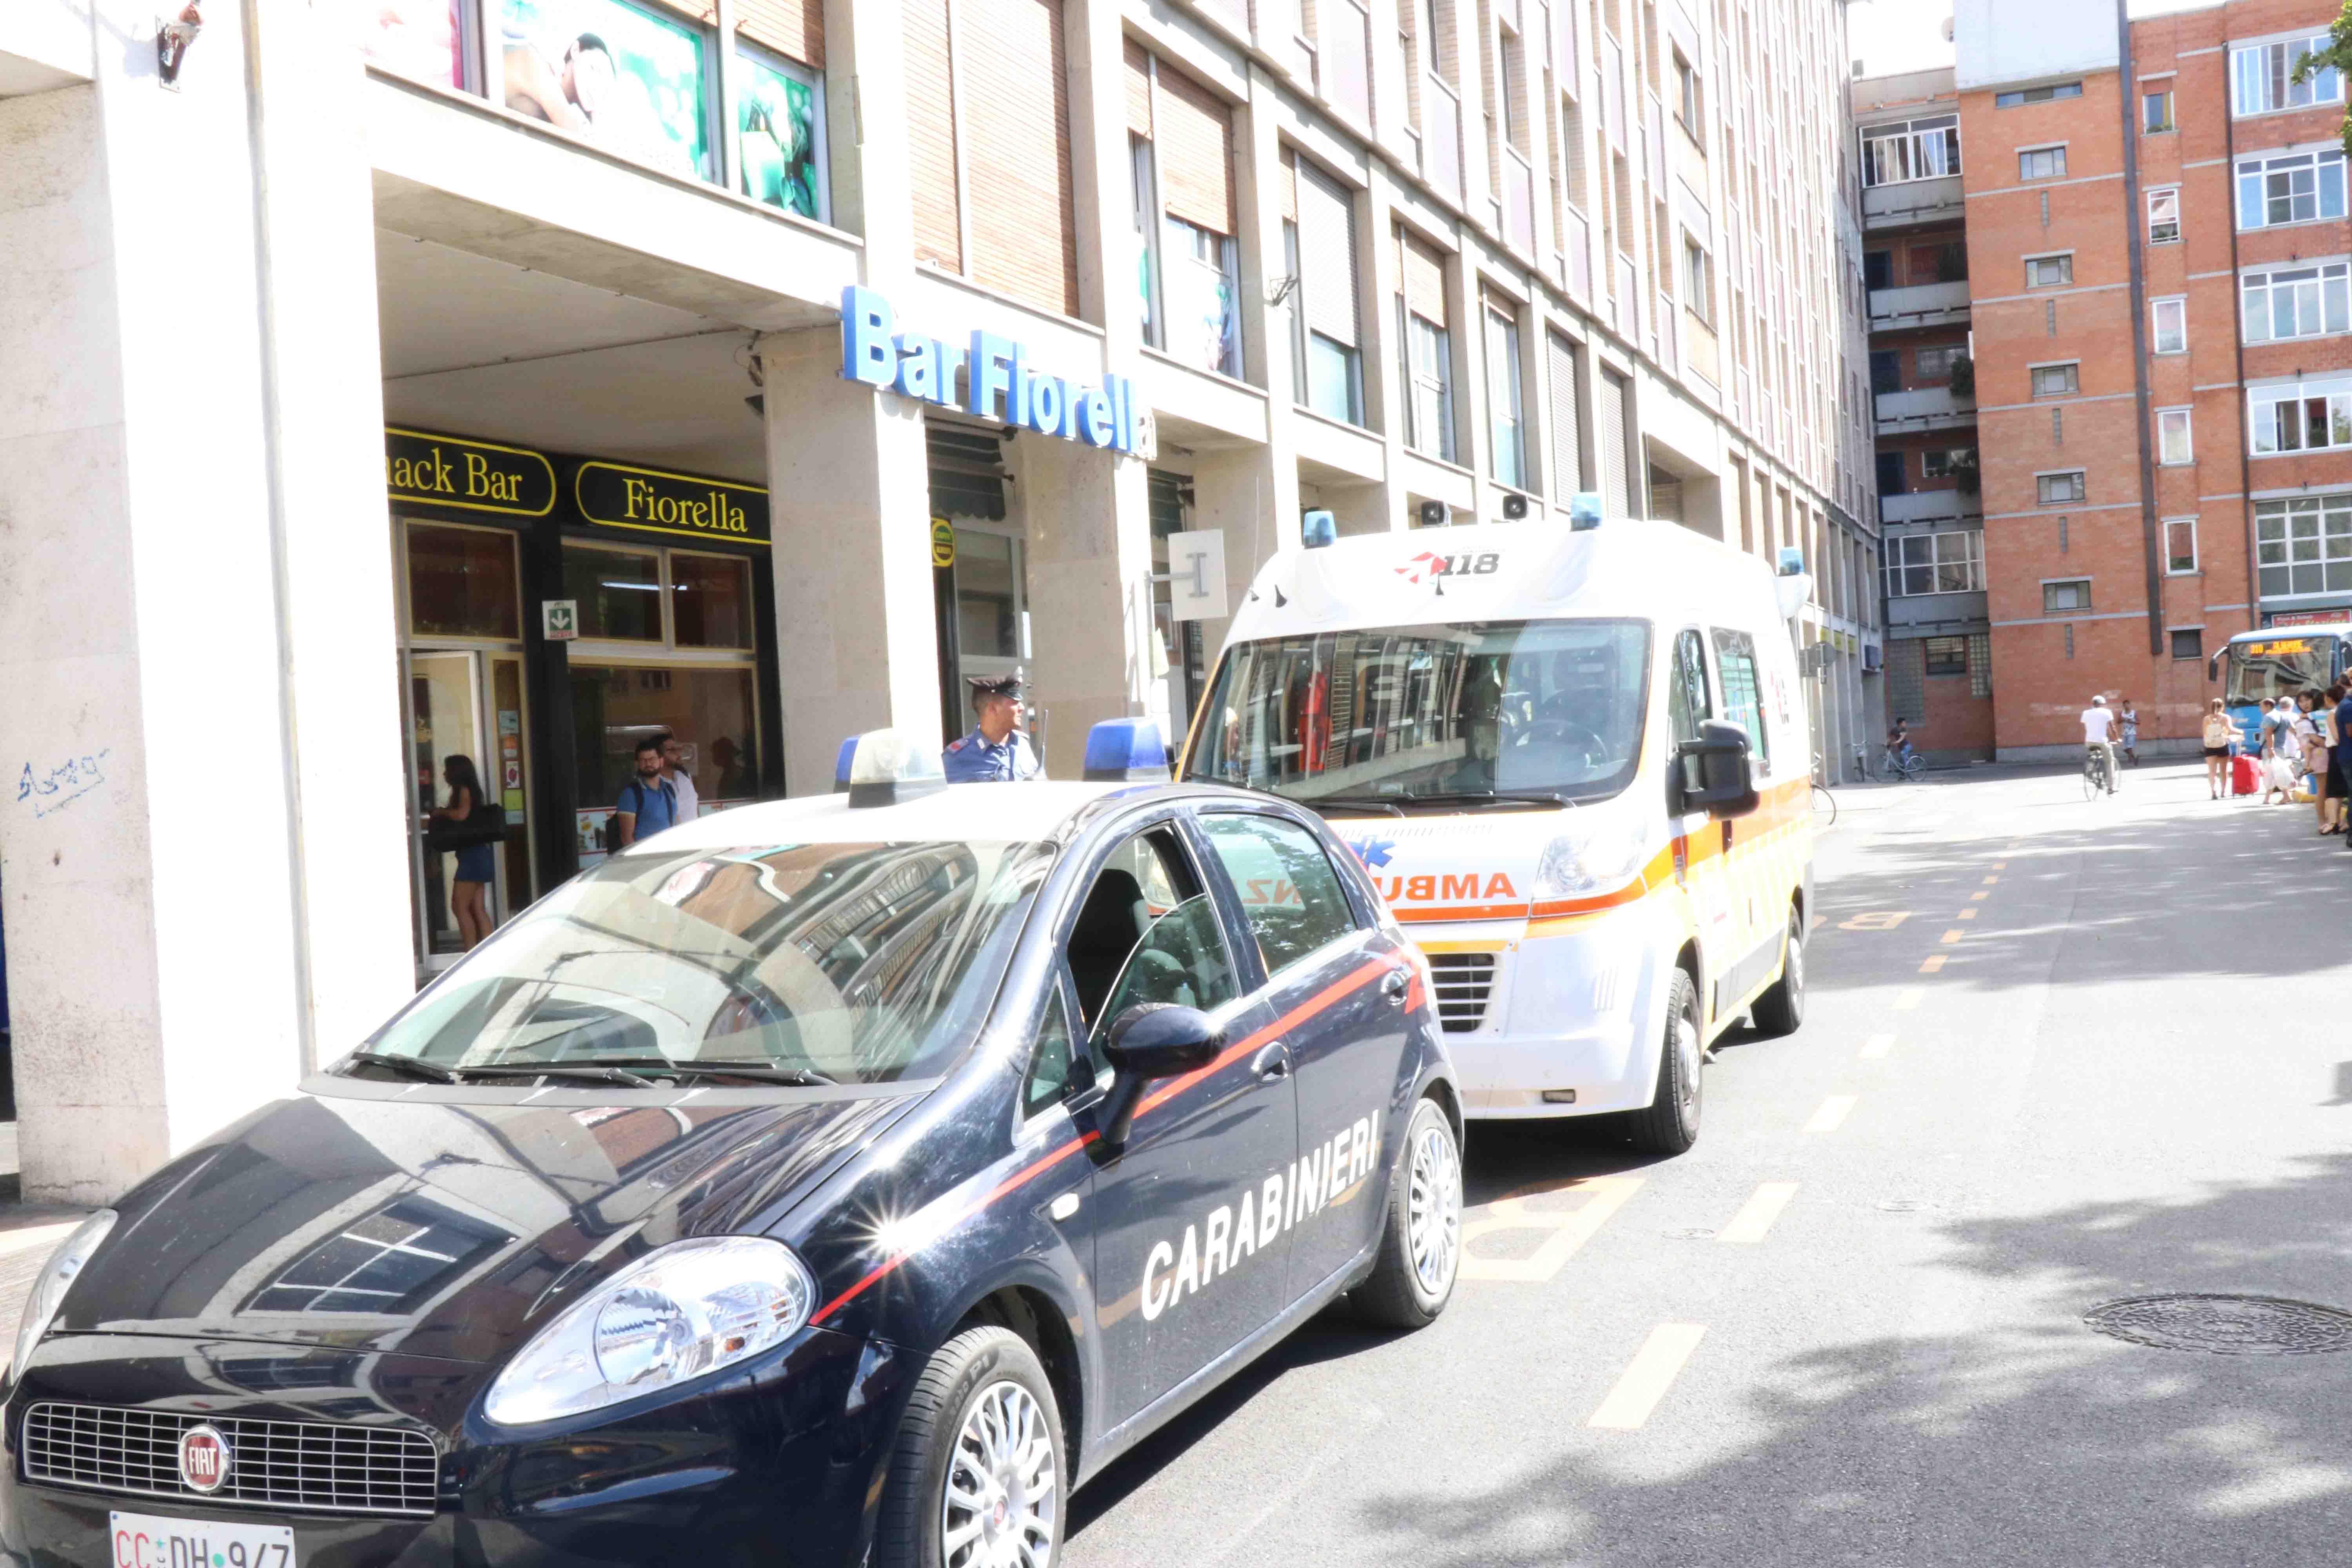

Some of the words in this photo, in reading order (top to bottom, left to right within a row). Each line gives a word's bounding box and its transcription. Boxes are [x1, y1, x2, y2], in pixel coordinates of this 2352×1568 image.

[842, 285, 966, 405] Bar
[463, 452, 523, 502] Bar
[622, 478, 748, 533] Fiorella
[1439, 553, 1500, 576] 118
[1141, 1109, 1379, 1321] CARABINIERI
[188, 1447, 217, 1475] FIAT
[115, 1530, 151, 1568] CC
